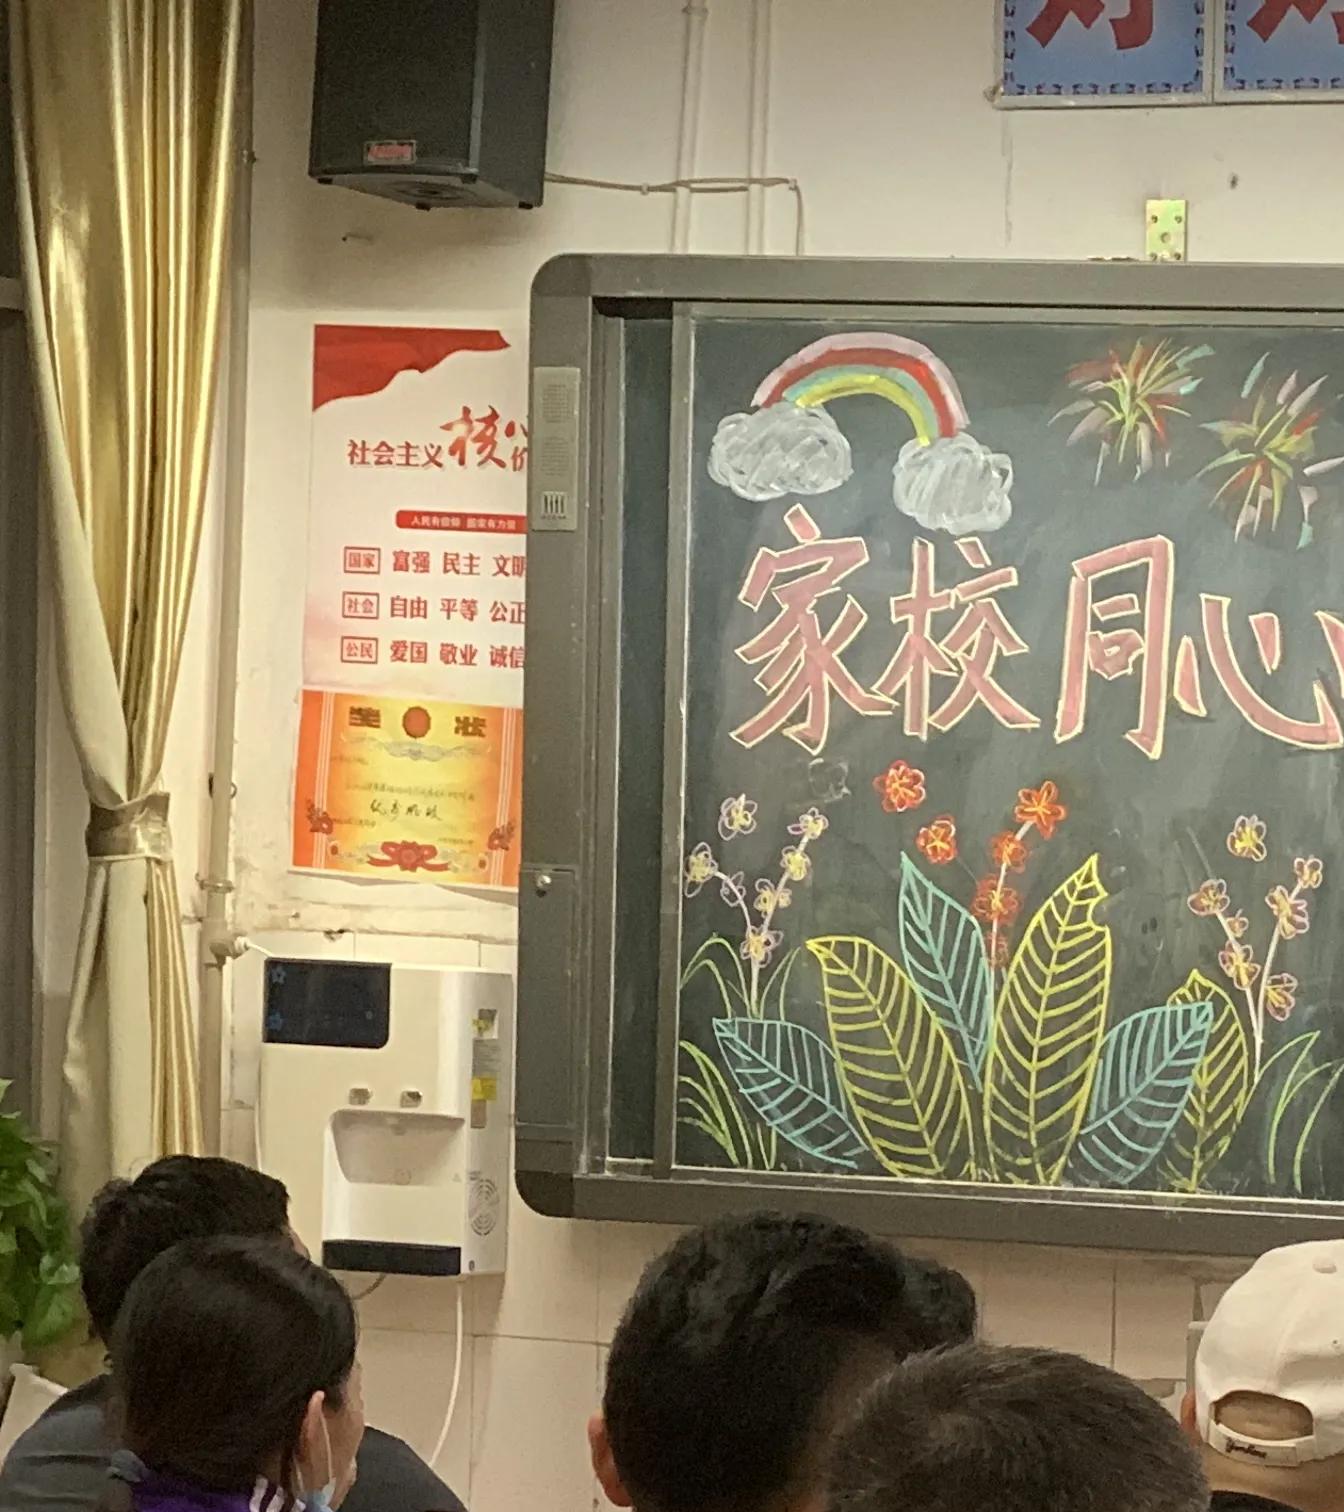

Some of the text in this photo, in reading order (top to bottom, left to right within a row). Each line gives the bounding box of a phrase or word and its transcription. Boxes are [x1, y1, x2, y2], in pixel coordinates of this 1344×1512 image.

[348, 552, 375, 569] 国家
[393, 550, 430, 574] 富强
[443, 552, 481, 576] 民主
[348, 596, 526, 625] 社会 自由 平等 公正
[346, 640, 525, 668] 公民 爱国 敬业 诚信
